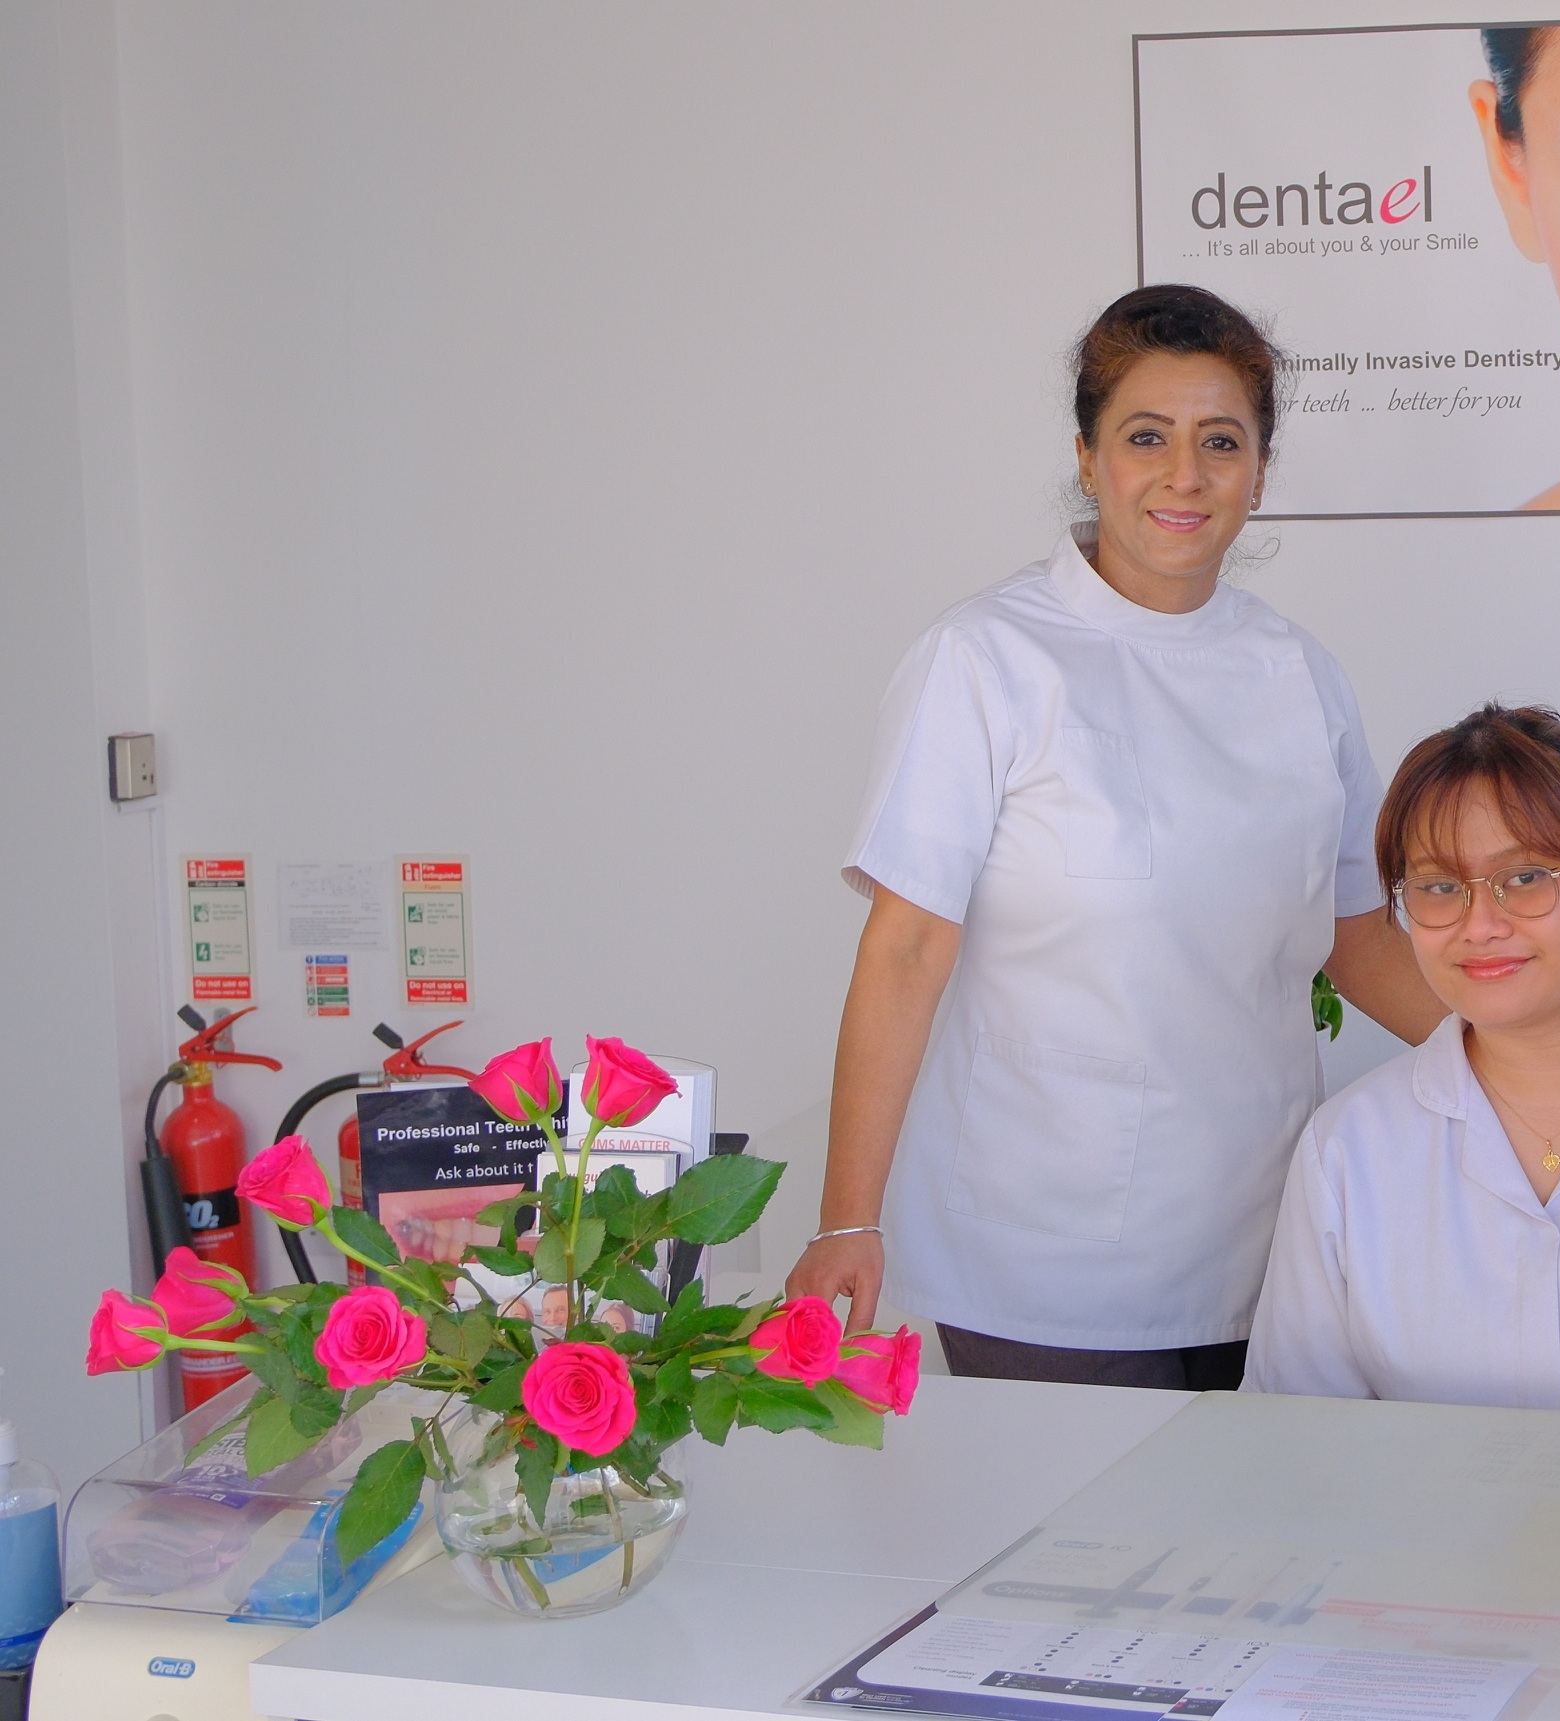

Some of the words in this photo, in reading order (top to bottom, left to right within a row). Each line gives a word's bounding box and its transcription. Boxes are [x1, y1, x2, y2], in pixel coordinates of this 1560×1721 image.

[1191, 165, 1433, 230] dentael
[1239, 238, 1259, 256] all
[1265, 237, 1316, 256] about
[1320, 238, 1354, 258] you
[1360, 235, 1374, 253] &
[1379, 237, 1421, 256] your
[1426, 233, 1480, 251] Smile
[1366, 350, 1457, 371] Invasive
[1302, 388, 1351, 414] teeth
[1387, 387, 1449, 412] better
[1442, 385, 1483, 418] for
[1480, 394, 1524, 418] you
[377, 1121, 480, 1143] Professional
[453, 1142, 481, 1155] Safe
[619, 1139, 671, 1152] MATTER
[435, 1166, 462, 1181] Ask
[466, 1163, 510, 1178] about
[514, 1162, 525, 1175] it
[150, 1660, 193, 1676] Oral-B
[913, 1665, 948, 1673] Cleaning
